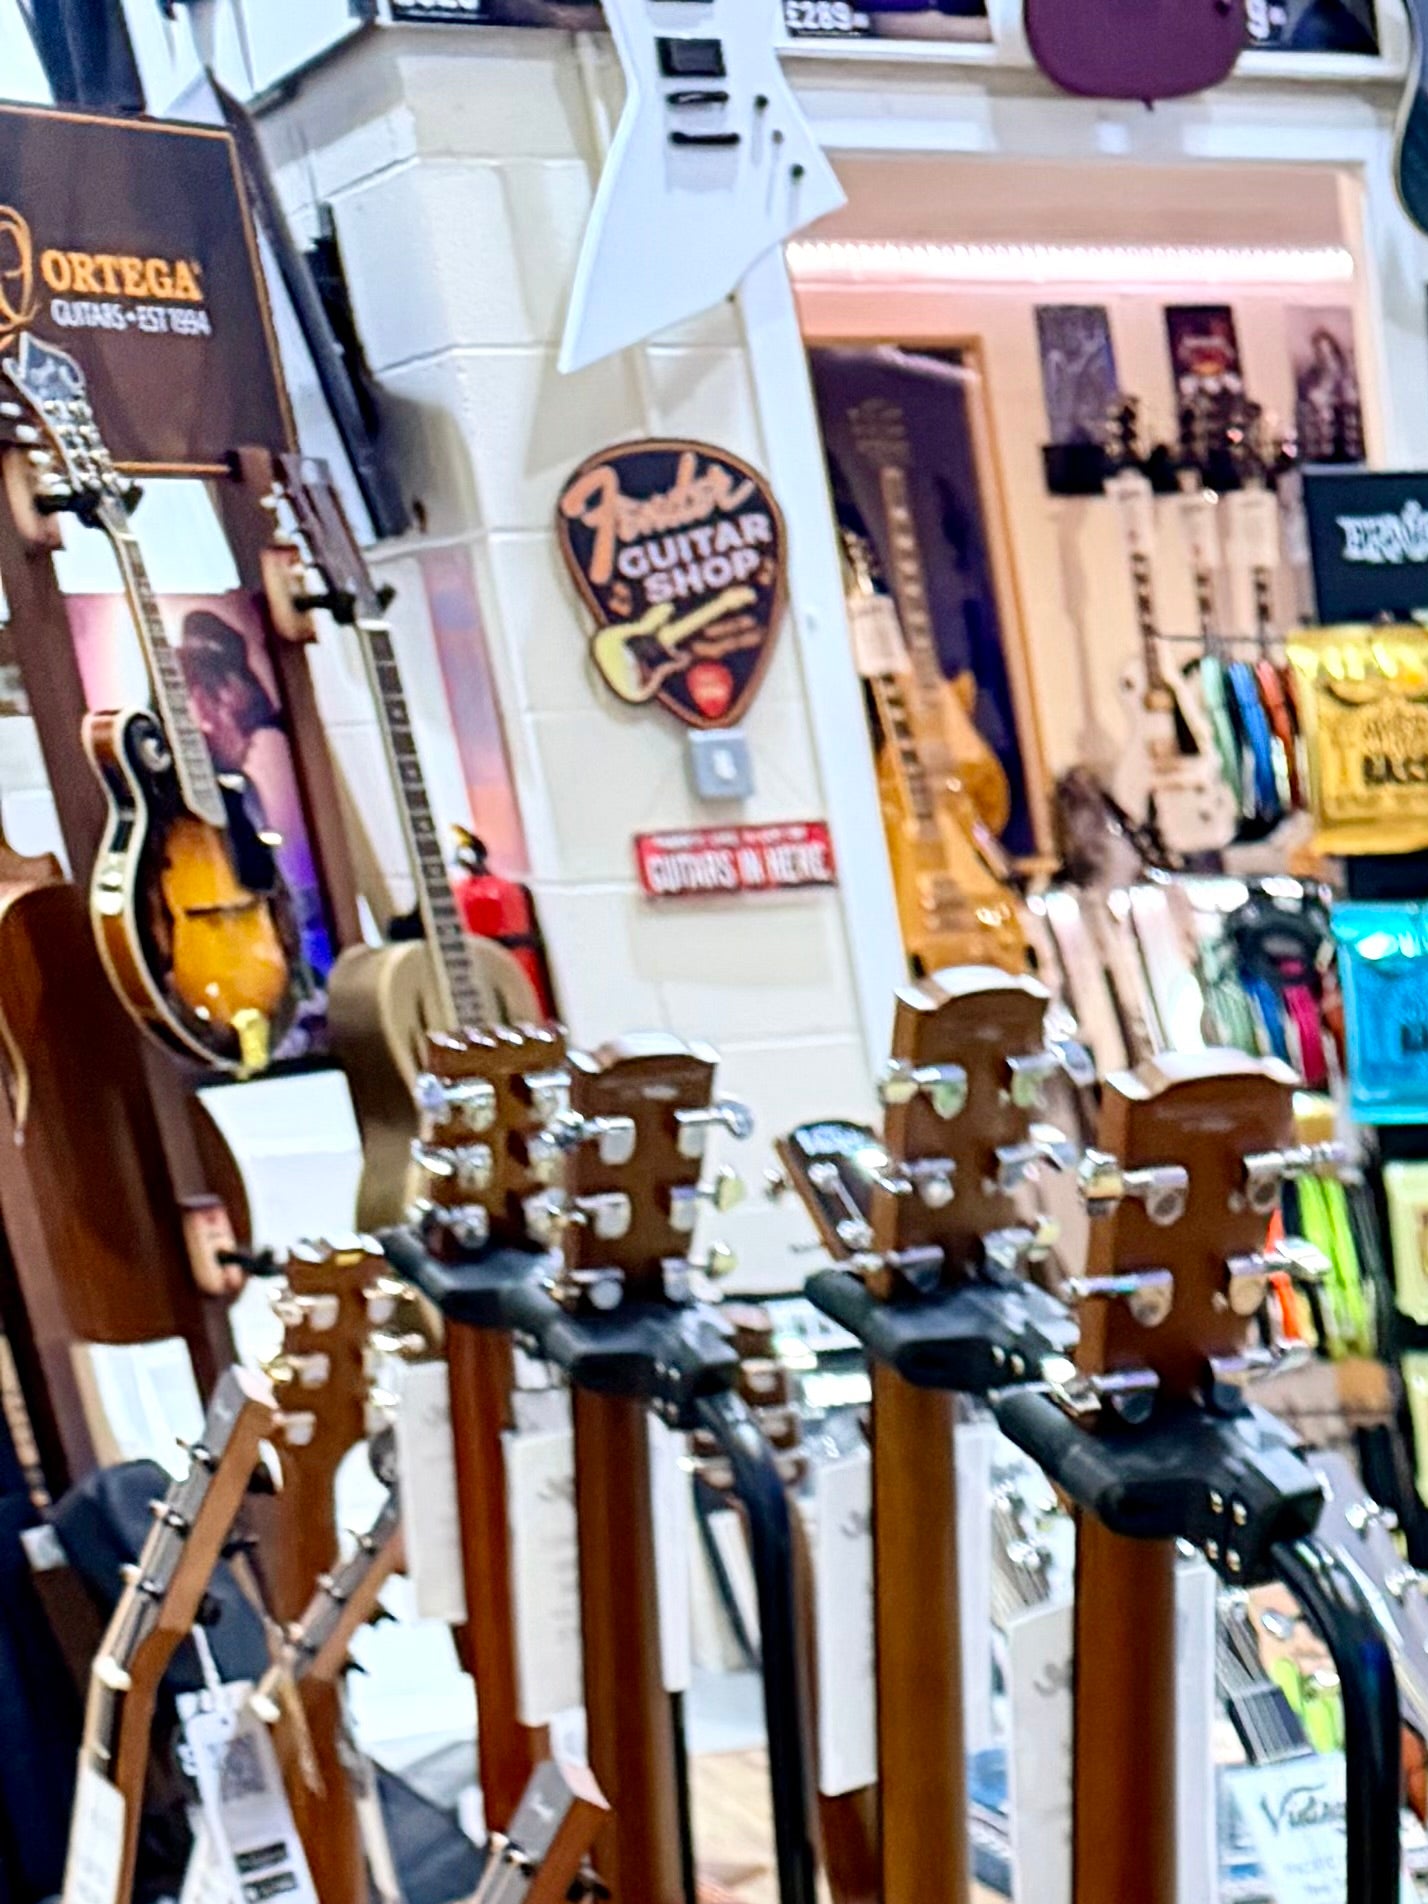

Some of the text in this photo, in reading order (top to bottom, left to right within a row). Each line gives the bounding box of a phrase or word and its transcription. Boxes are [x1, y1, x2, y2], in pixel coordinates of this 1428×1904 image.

[41, 249, 204, 302] ORTEGA
[561, 451, 756, 585] Fender
[617, 513, 773, 580] GUITAR
[642, 548, 761, 604] SHOP
